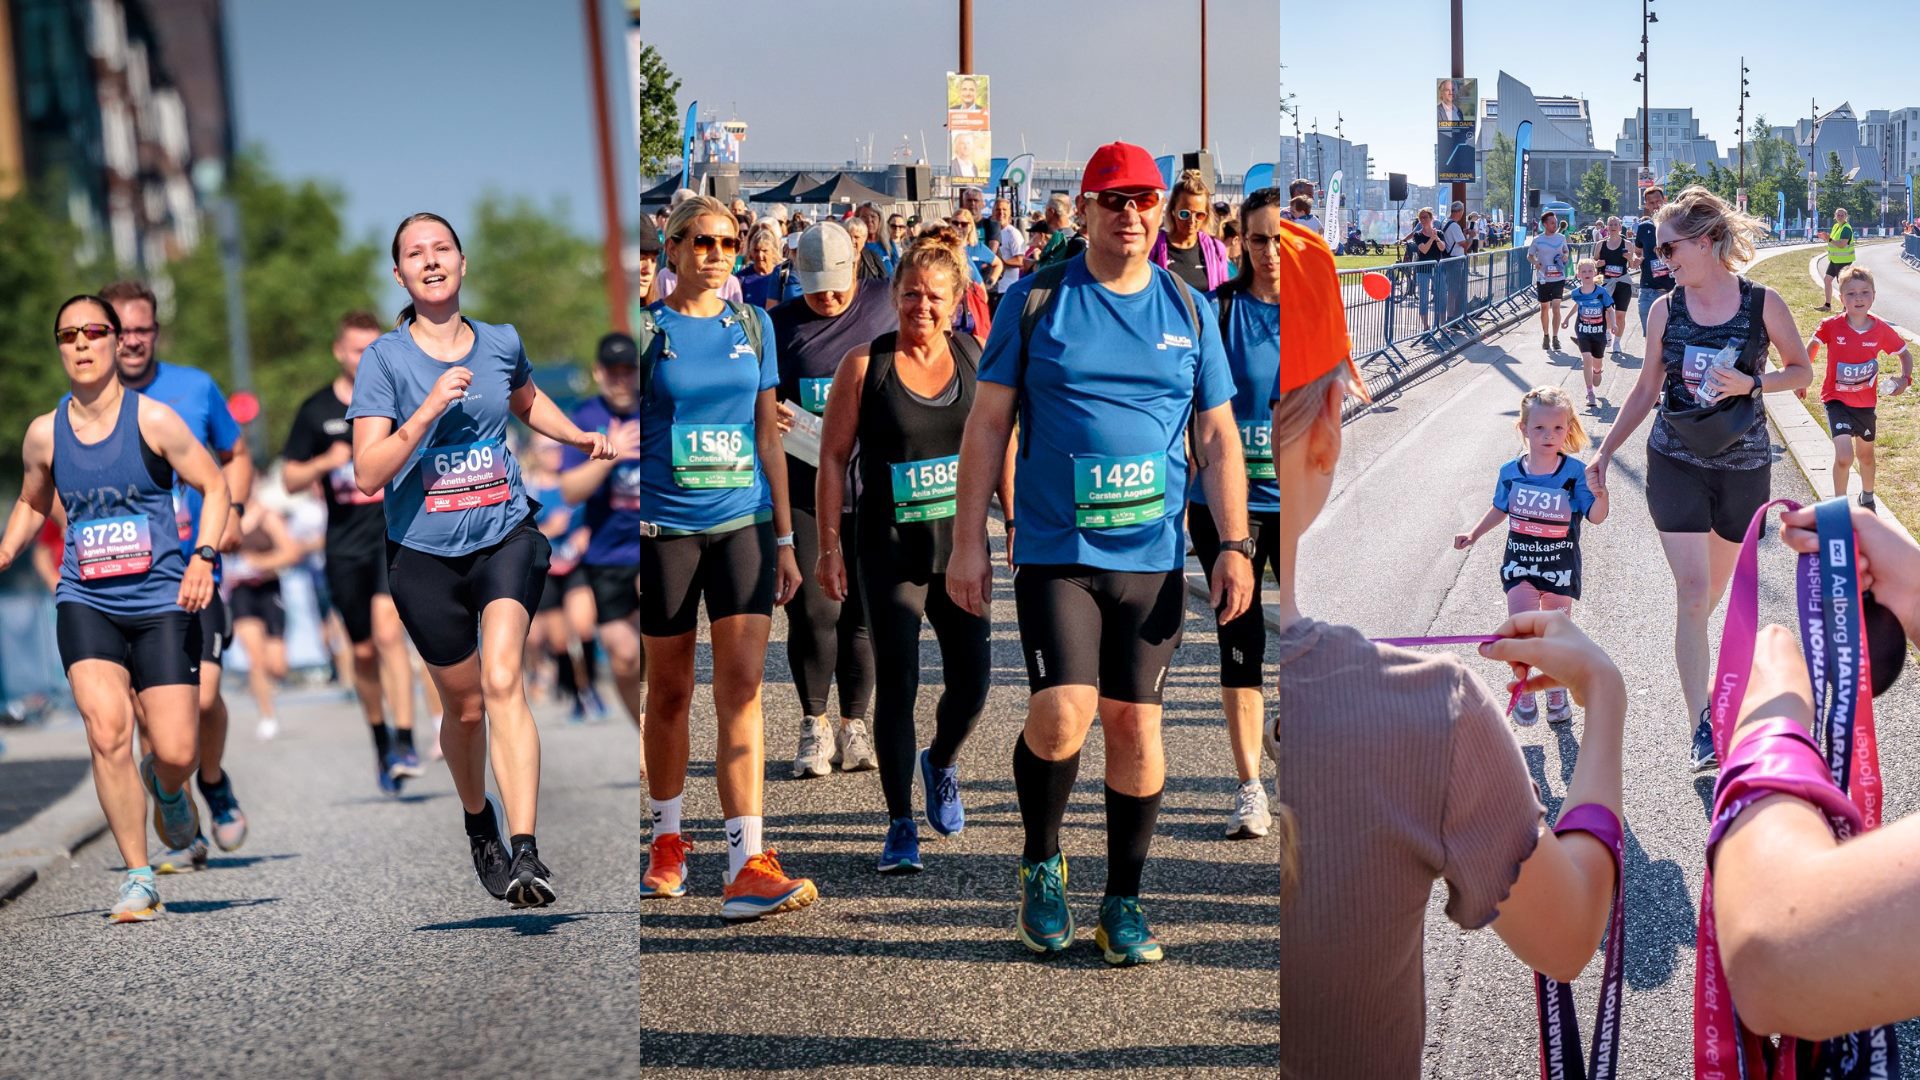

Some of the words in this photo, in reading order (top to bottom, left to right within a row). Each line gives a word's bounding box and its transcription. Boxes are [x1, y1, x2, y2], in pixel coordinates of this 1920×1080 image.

[1843, 362, 1874, 377] 6142
[686, 430, 743, 453] 1586
[434, 446, 493, 476] 6509
[905, 461, 958, 489] 1588
[1090, 460, 1155, 488] 1426
[440, 477, 466, 486] Anette
[467, 471, 494, 482] Schultz
[911, 490, 931, 498] Anita
[1088, 491, 1122, 500] Carsten
[1516, 488, 1562, 511] 5731
[82, 520, 138, 548] 3728
[1507, 538, 1573, 553] Sparekassen
[1831, 574, 1849, 644] Aalborg
[1034, 649, 1047, 678] FUSION
[1717, 672, 1738, 723] Under
[1855, 726, 1877, 786] fjorden
[1864, 791, 1876, 828] over
[1704, 945, 1719, 1010] vandet
[1596, 981, 1617, 1080] MARATHON
[1704, 1025, 1720, 1065] over
